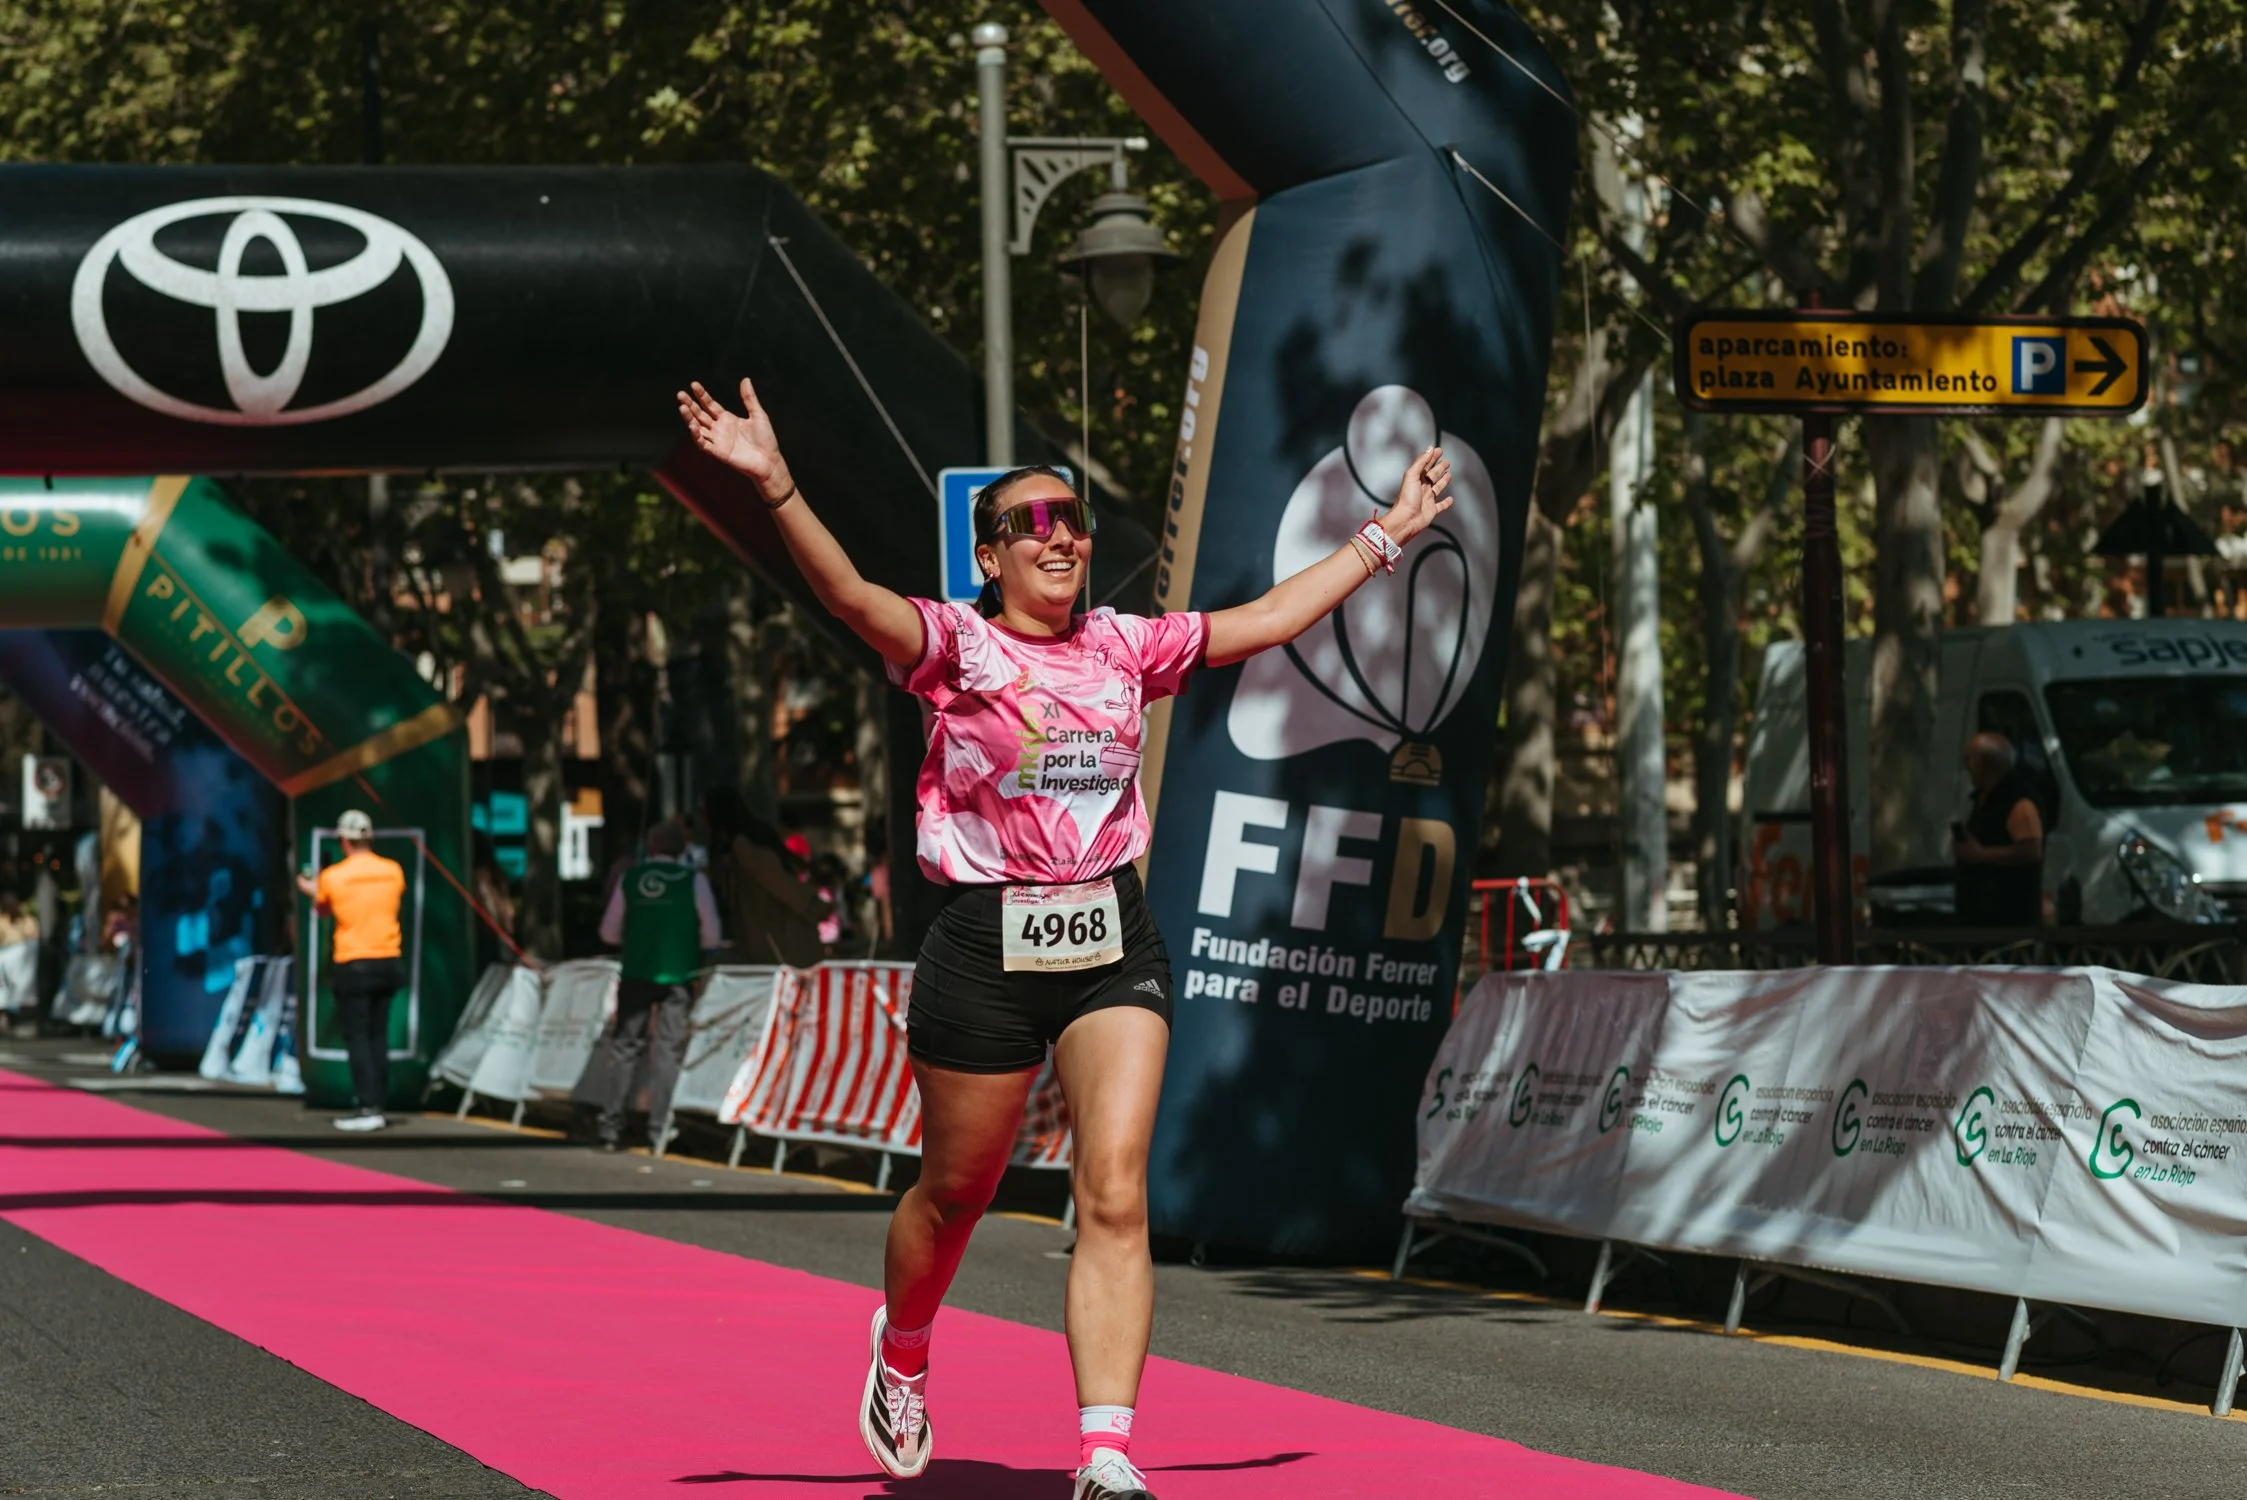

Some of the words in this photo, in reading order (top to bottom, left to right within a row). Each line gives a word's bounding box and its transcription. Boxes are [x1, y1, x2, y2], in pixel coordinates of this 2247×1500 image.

[1385, 0, 1471, 83] rer.org
[1699, 334, 1907, 365] aparcamiento:
[2020, 341, 2056, 390] P
[1700, 365, 1774, 395] plaza
[1796, 366, 1997, 395] Ayuntamiento
[145, 573, 327, 758] PITILLOS
[1040, 702, 1061, 719] XI
[1045, 726, 1114, 743] Carrera
[1044, 753, 1076, 771] por
[1080, 750, 1096, 768] la
[1197, 789, 1456, 941] FFD
[1021, 907, 1107, 948] 4968
[1190, 926, 1356, 979] Fundación
[1365, 952, 1438, 985] Ferrer
[1184, 968, 1260, 1003] para
[1277, 981, 1310, 1010] el
[1326, 985, 1432, 1024] Deporte
[1994, 1122, 2025, 1138] contra
[2026, 1122, 2036, 1139] el
[2150, 1111, 2208, 1133] asociación
[2209, 1113, 2247, 1138] españo
[1860, 1138, 1873, 1153] en
[1987, 1148, 1999, 1162] en
[2001, 1146, 2013, 1164] La
[2014, 1146, 2037, 1170] Rioja
[2142, 1137, 2180, 1157] contra
[2181, 1139, 2193, 1157] el
[2193, 1139, 2231, 1160] cáncer
[2133, 1165, 2152, 1179] en
[2151, 1163, 2167, 1182] La
[2168, 1164, 2197, 1188] Rioja
